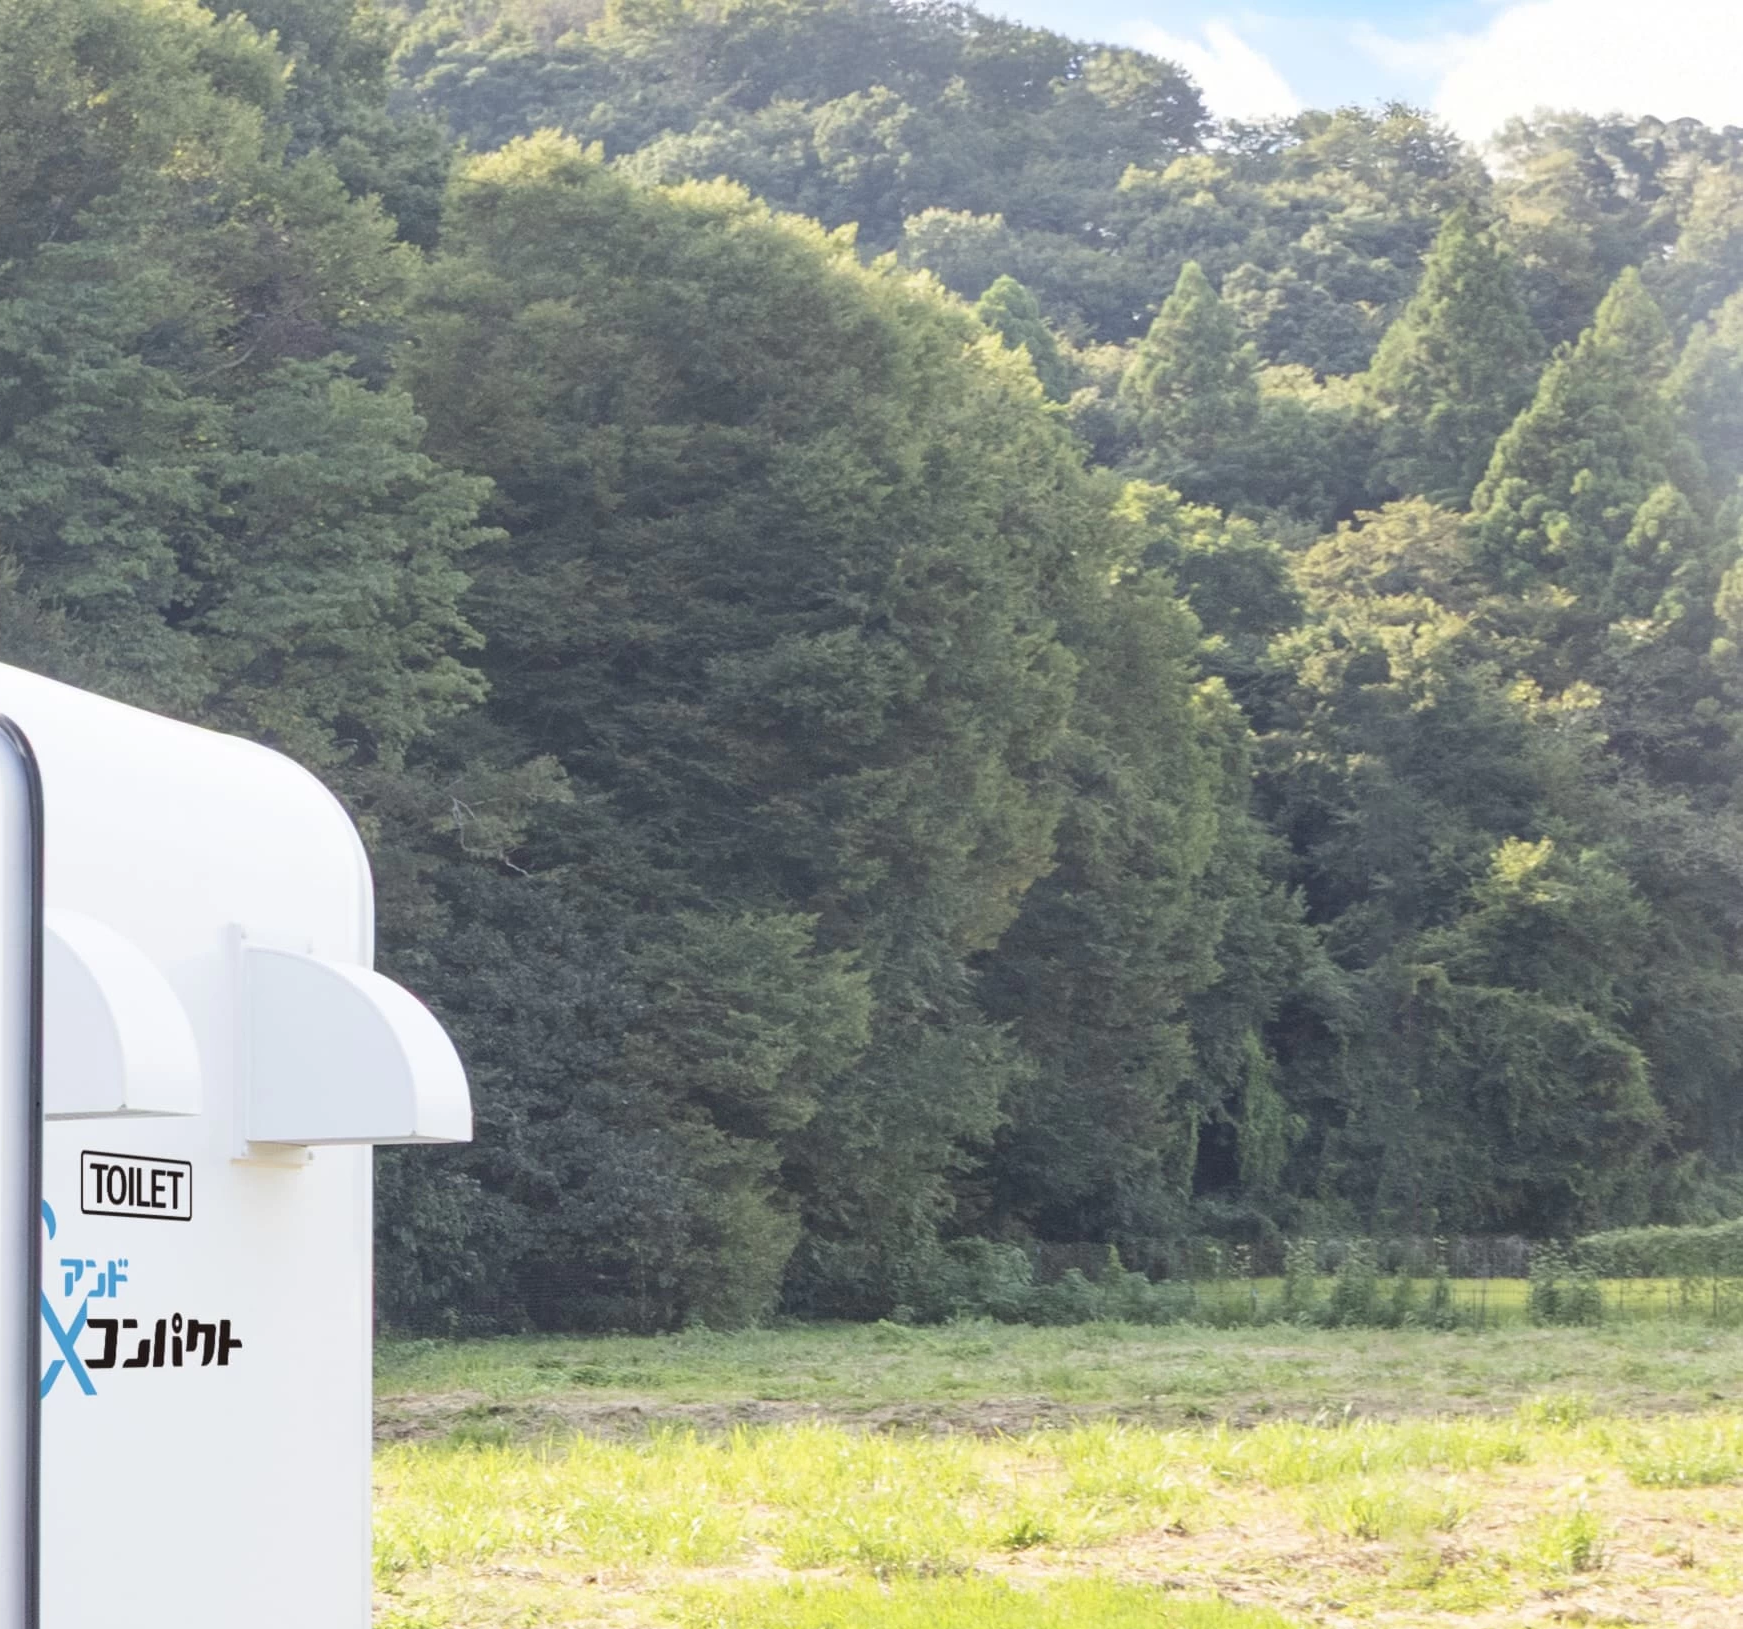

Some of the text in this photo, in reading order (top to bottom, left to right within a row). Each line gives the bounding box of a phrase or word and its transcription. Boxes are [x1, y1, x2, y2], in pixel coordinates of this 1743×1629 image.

[89, 1162, 185, 1210] TOILET
[59, 1257, 129, 1298] アンド
[84, 1312, 243, 1369] コンパクト
